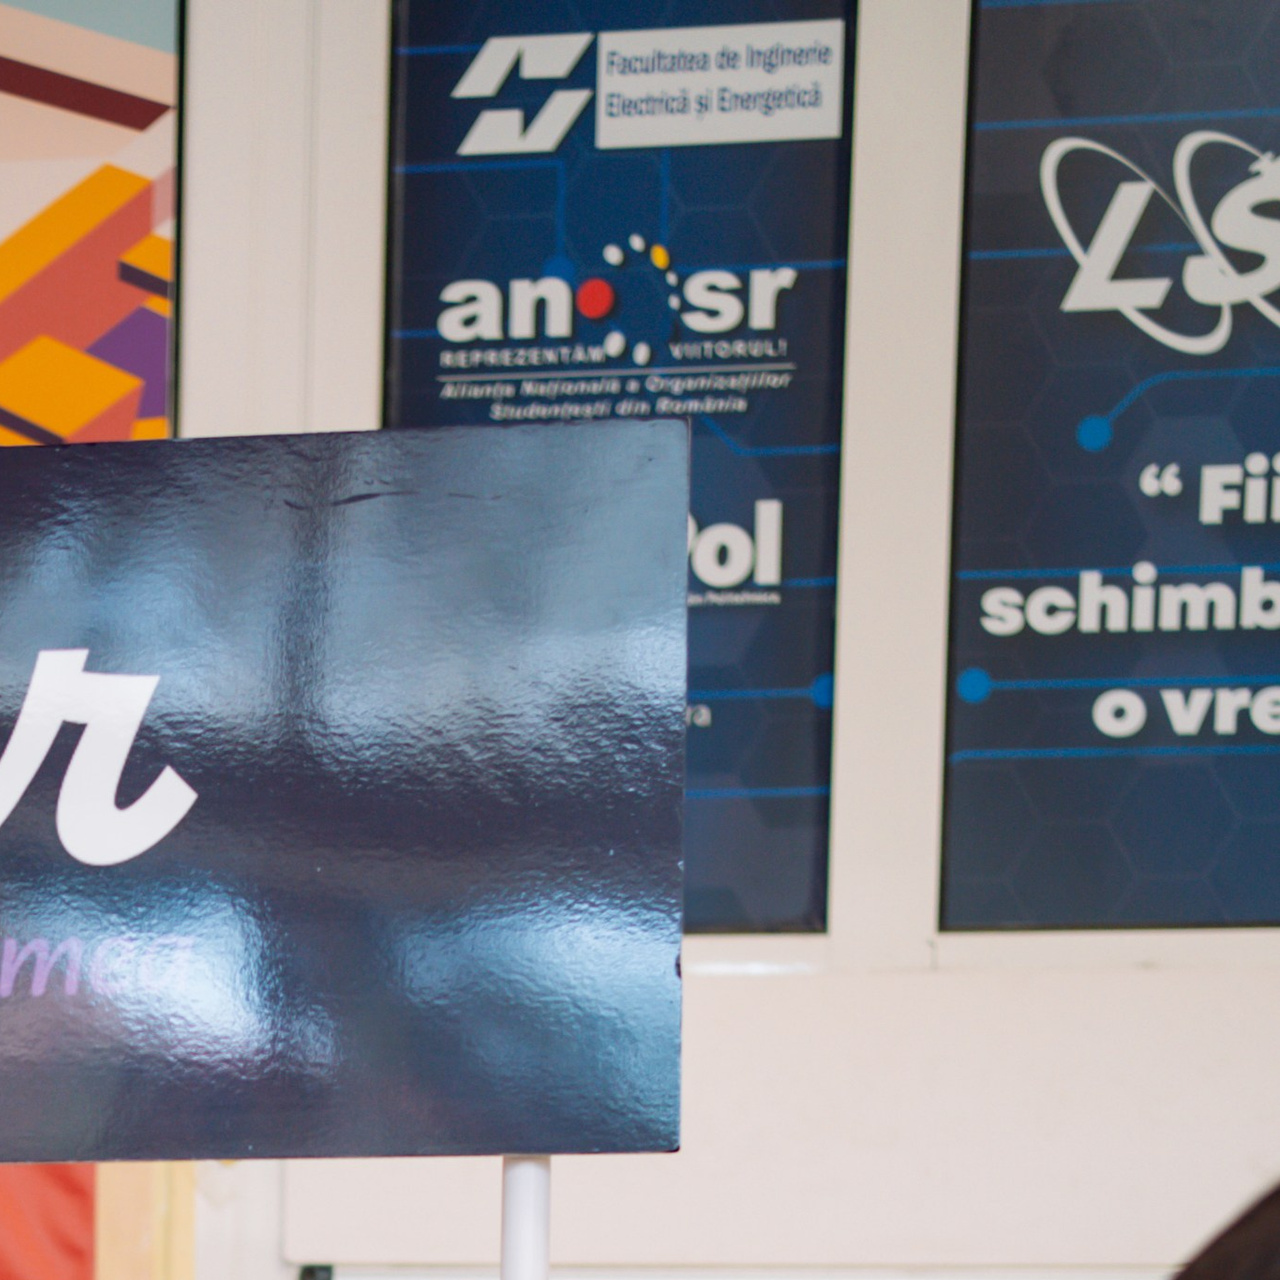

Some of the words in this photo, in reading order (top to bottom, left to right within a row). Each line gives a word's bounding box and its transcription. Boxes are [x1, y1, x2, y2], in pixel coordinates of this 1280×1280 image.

[606, 50, 711, 76] Facultatea
[715, 46, 742, 69] de
[746, 42, 833, 74] Inginerie
[1092, 688, 1148, 738] o
